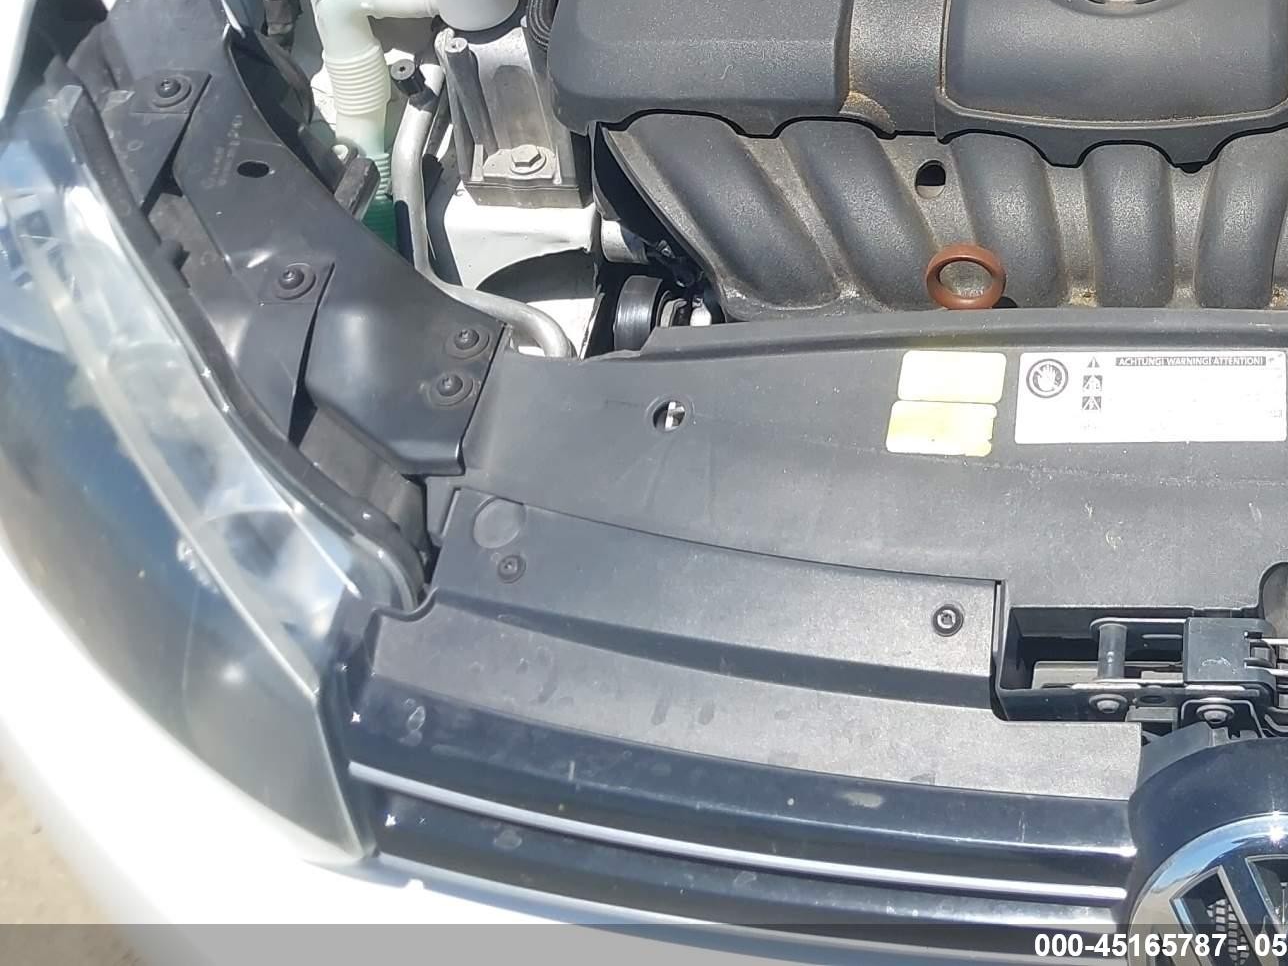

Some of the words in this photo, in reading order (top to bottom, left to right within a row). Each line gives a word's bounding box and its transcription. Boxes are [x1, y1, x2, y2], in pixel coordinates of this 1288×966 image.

[1118, 357, 1165, 367] ACHTUNG!
[1166, 356, 1212, 367] WARNING!
[1213, 356, 1264, 366] ATTENTION!
